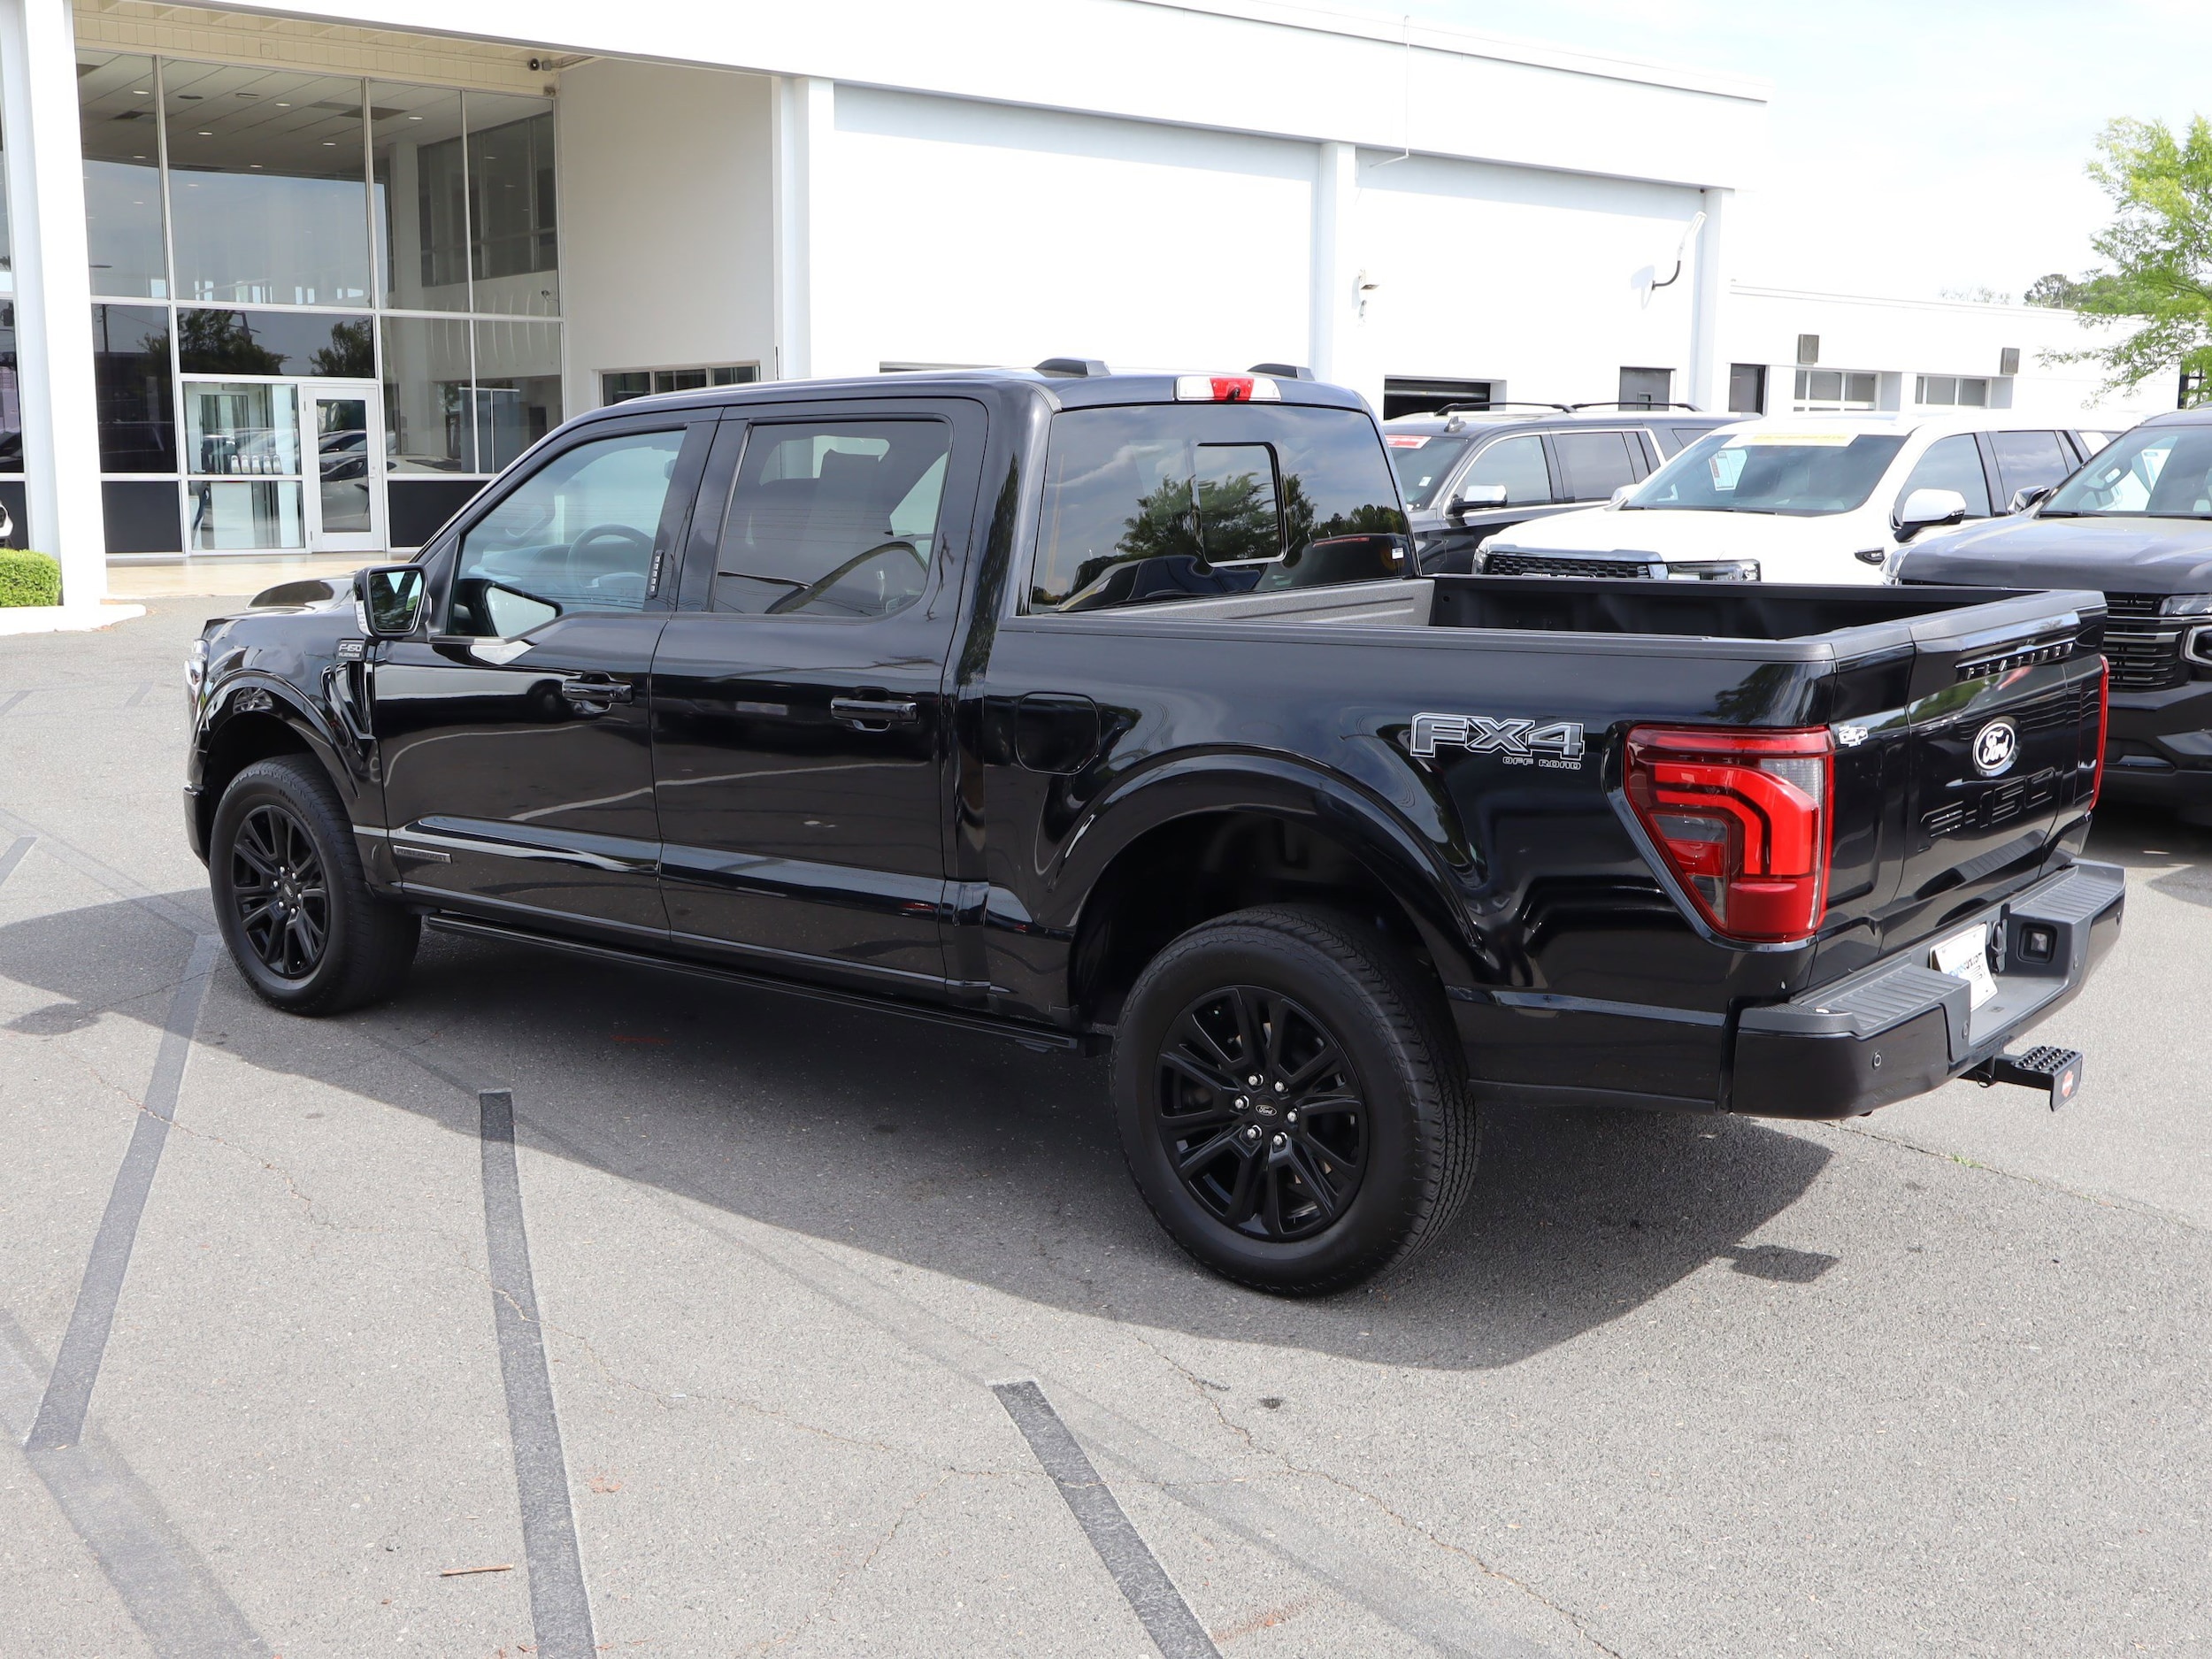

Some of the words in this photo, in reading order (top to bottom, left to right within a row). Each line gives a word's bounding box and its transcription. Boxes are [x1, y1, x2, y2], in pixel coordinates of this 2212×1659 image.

[1409, 712, 1585, 761] FX4
[1982, 728, 2010, 764] Ford
[1502, 756, 1533, 766] OFF
[1539, 758, 1582, 771] ROAD
[1920, 766, 2055, 838] F-150
